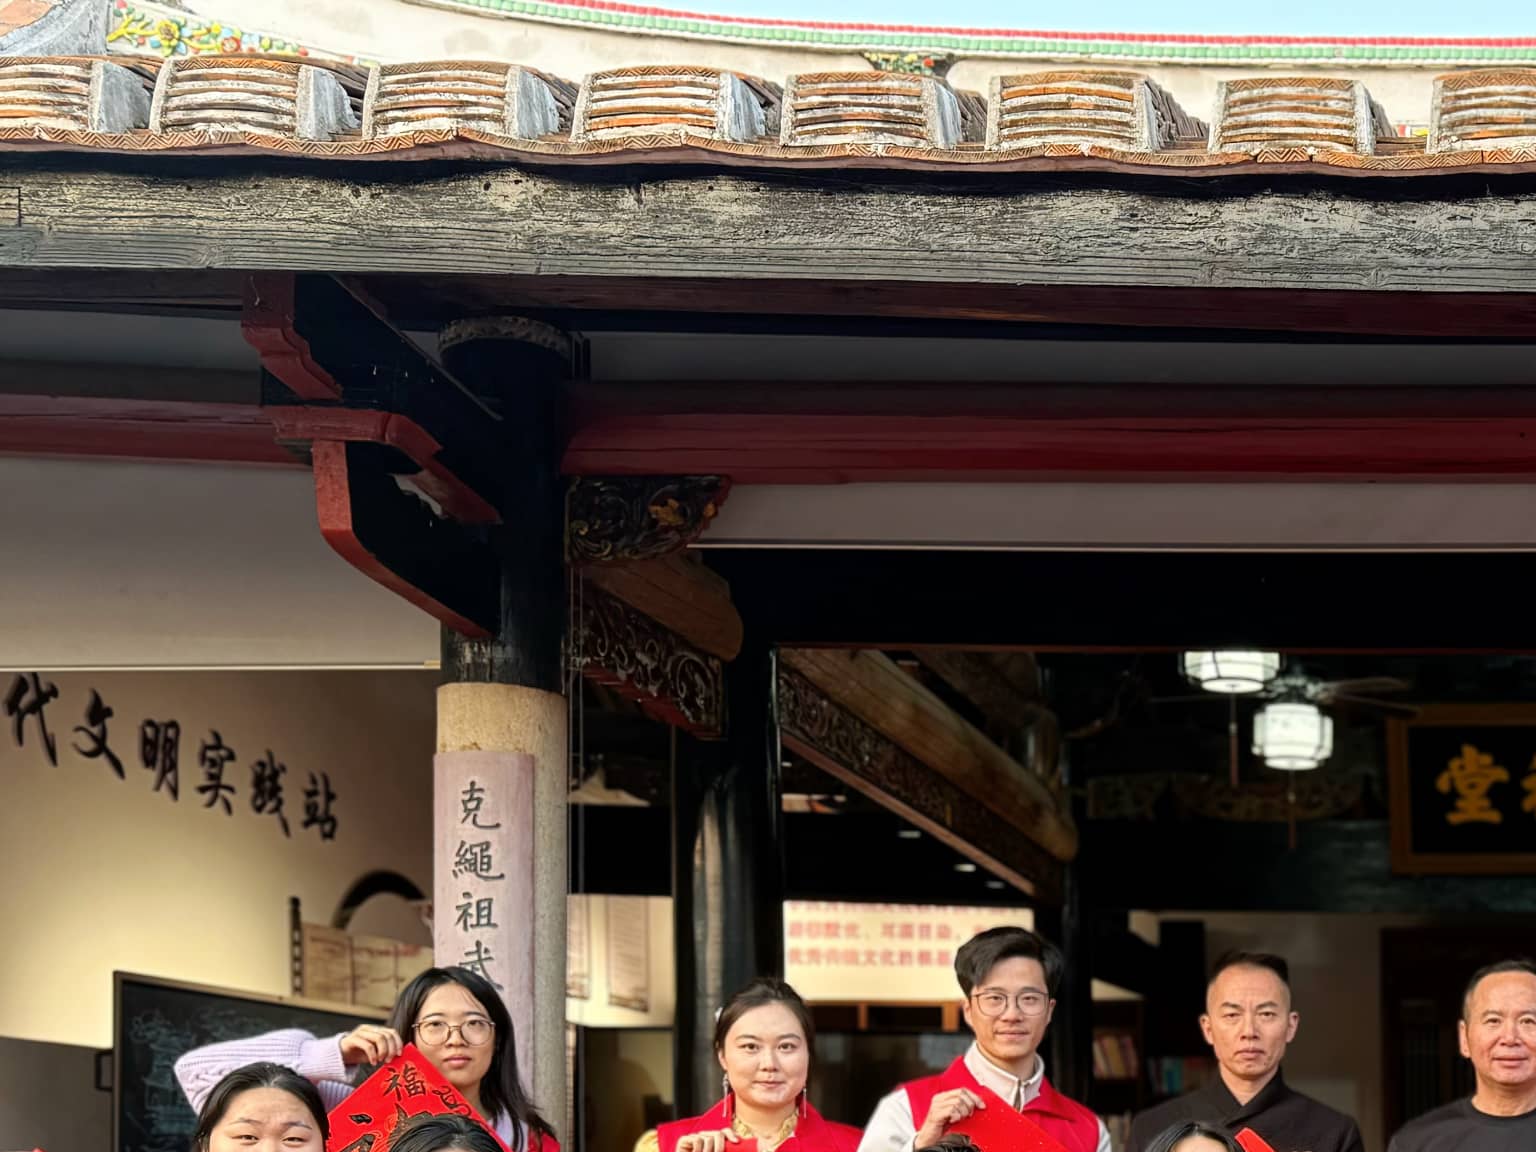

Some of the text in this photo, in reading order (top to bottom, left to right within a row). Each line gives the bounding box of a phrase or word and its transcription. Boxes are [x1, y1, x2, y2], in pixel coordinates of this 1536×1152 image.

[3, 672, 339, 841] 代文明实践站
[382, 1063, 427, 1098] 福
